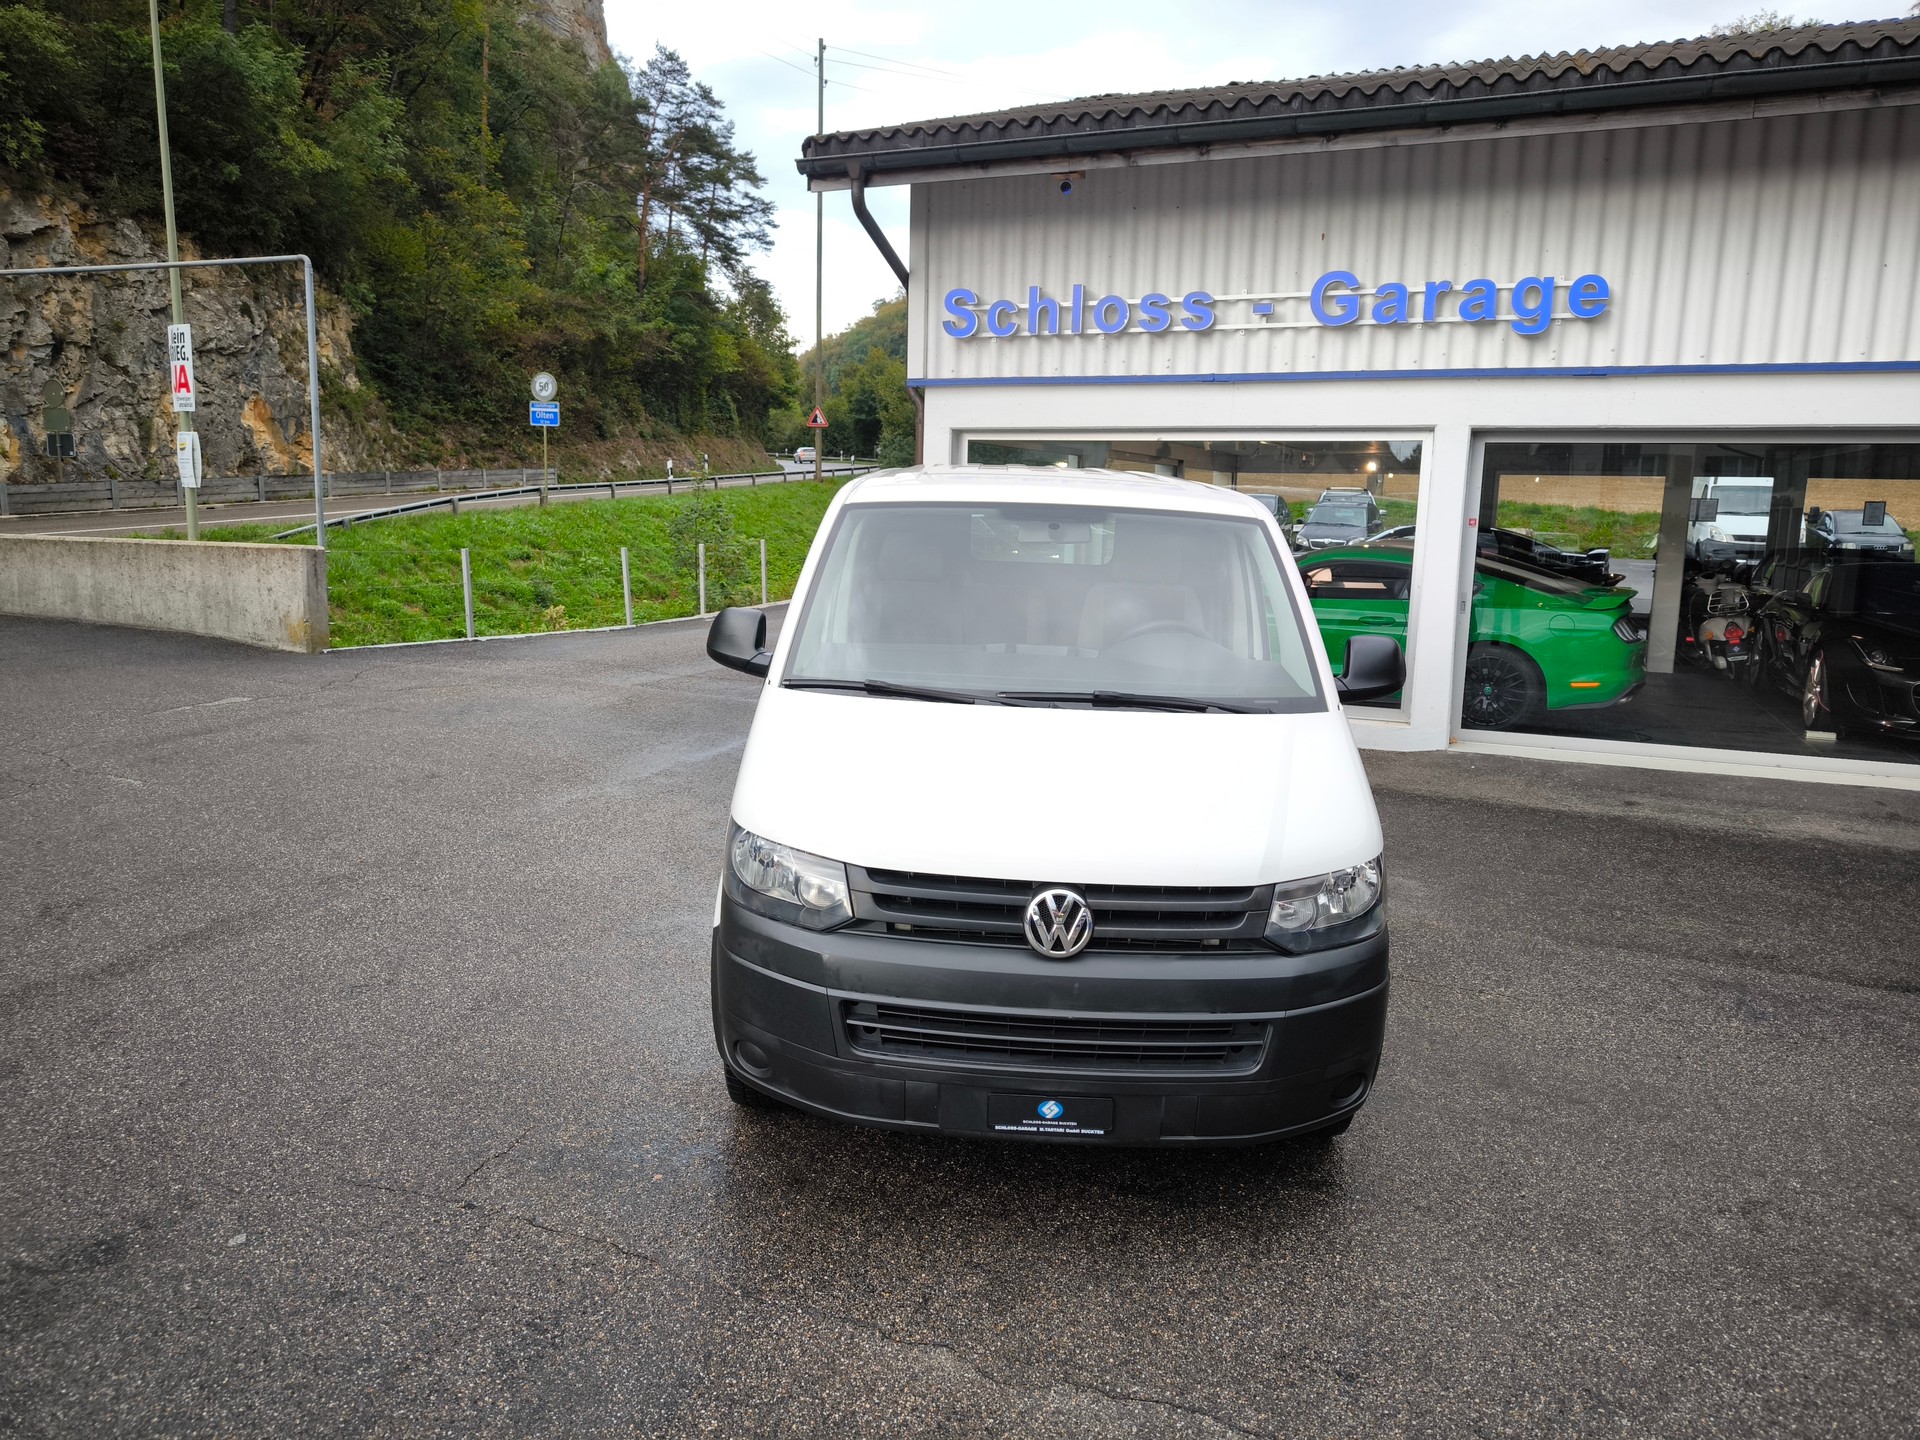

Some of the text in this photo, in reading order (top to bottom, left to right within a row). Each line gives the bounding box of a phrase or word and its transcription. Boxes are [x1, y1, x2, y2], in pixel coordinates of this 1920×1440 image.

[942, 283, 1215, 339] Schloss
[1309, 270, 1610, 337] Garage
[174, 365, 192, 393] JA
[538, 382, 548, 392] 50
[1024, 889, 1093, 958] VW
